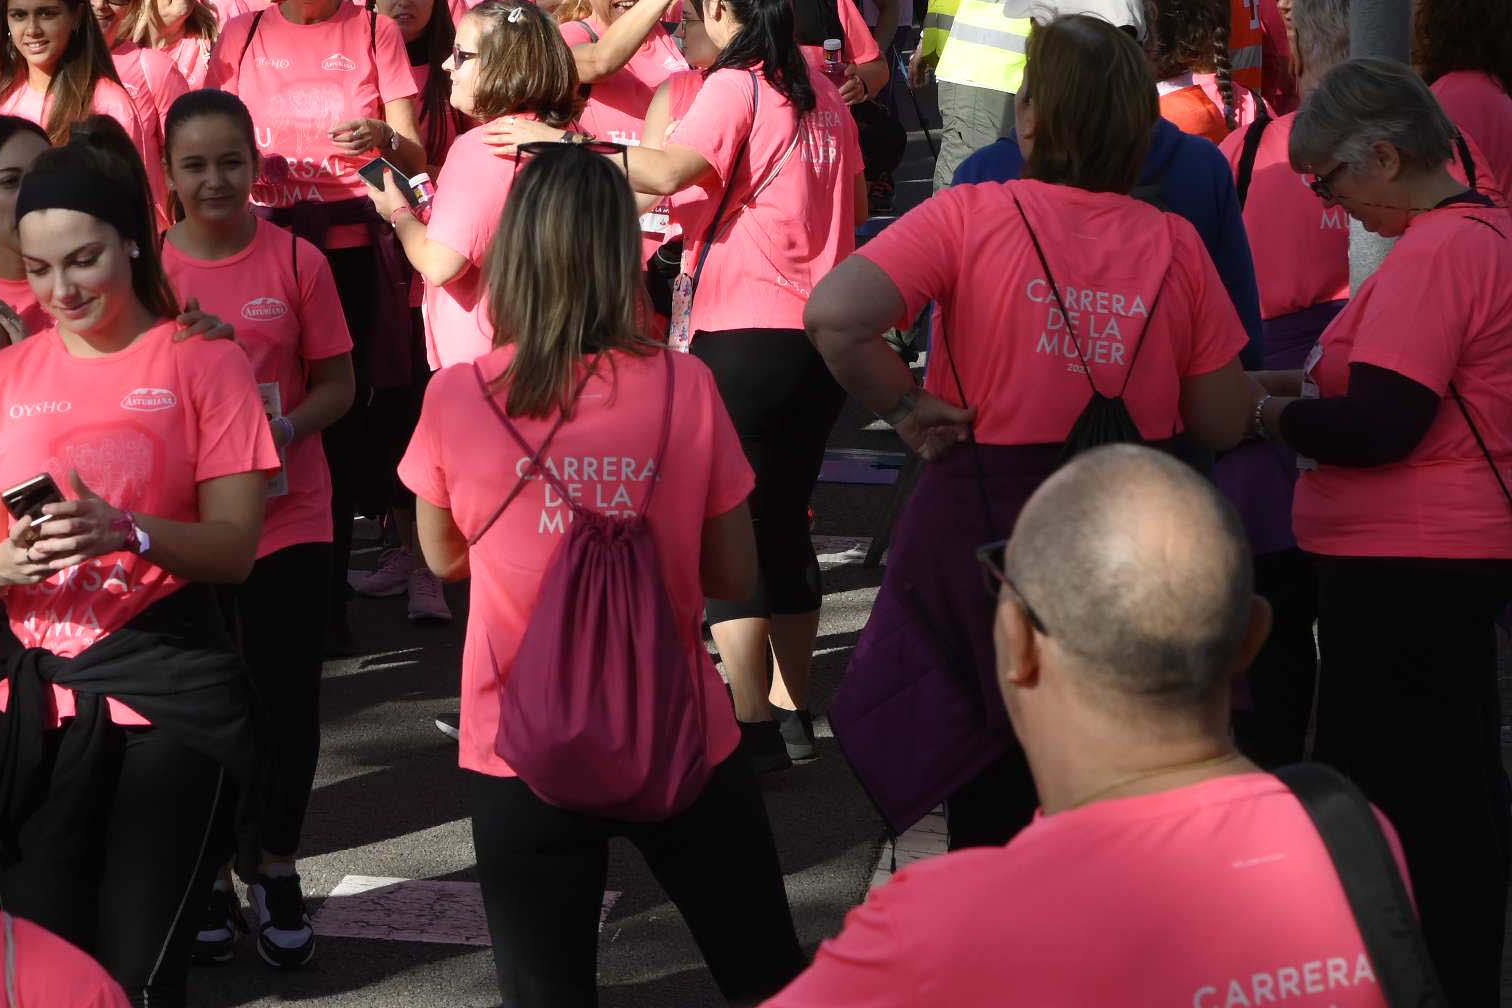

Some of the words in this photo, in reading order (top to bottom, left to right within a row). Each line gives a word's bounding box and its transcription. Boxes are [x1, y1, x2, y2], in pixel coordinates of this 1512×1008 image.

[255, 128, 271, 147] U
[1026, 279, 1147, 318] CARRERA
[1090, 314, 1122, 340] LA
[1036, 334, 1125, 366] MUJER
[8, 400, 72, 419] OYSHO
[123, 394, 175, 409] ASTURIANA
[516, 455, 660, 481] CARRERA
[596, 484, 631, 505] LA
[1193, 954, 1376, 1008] CARRERA
